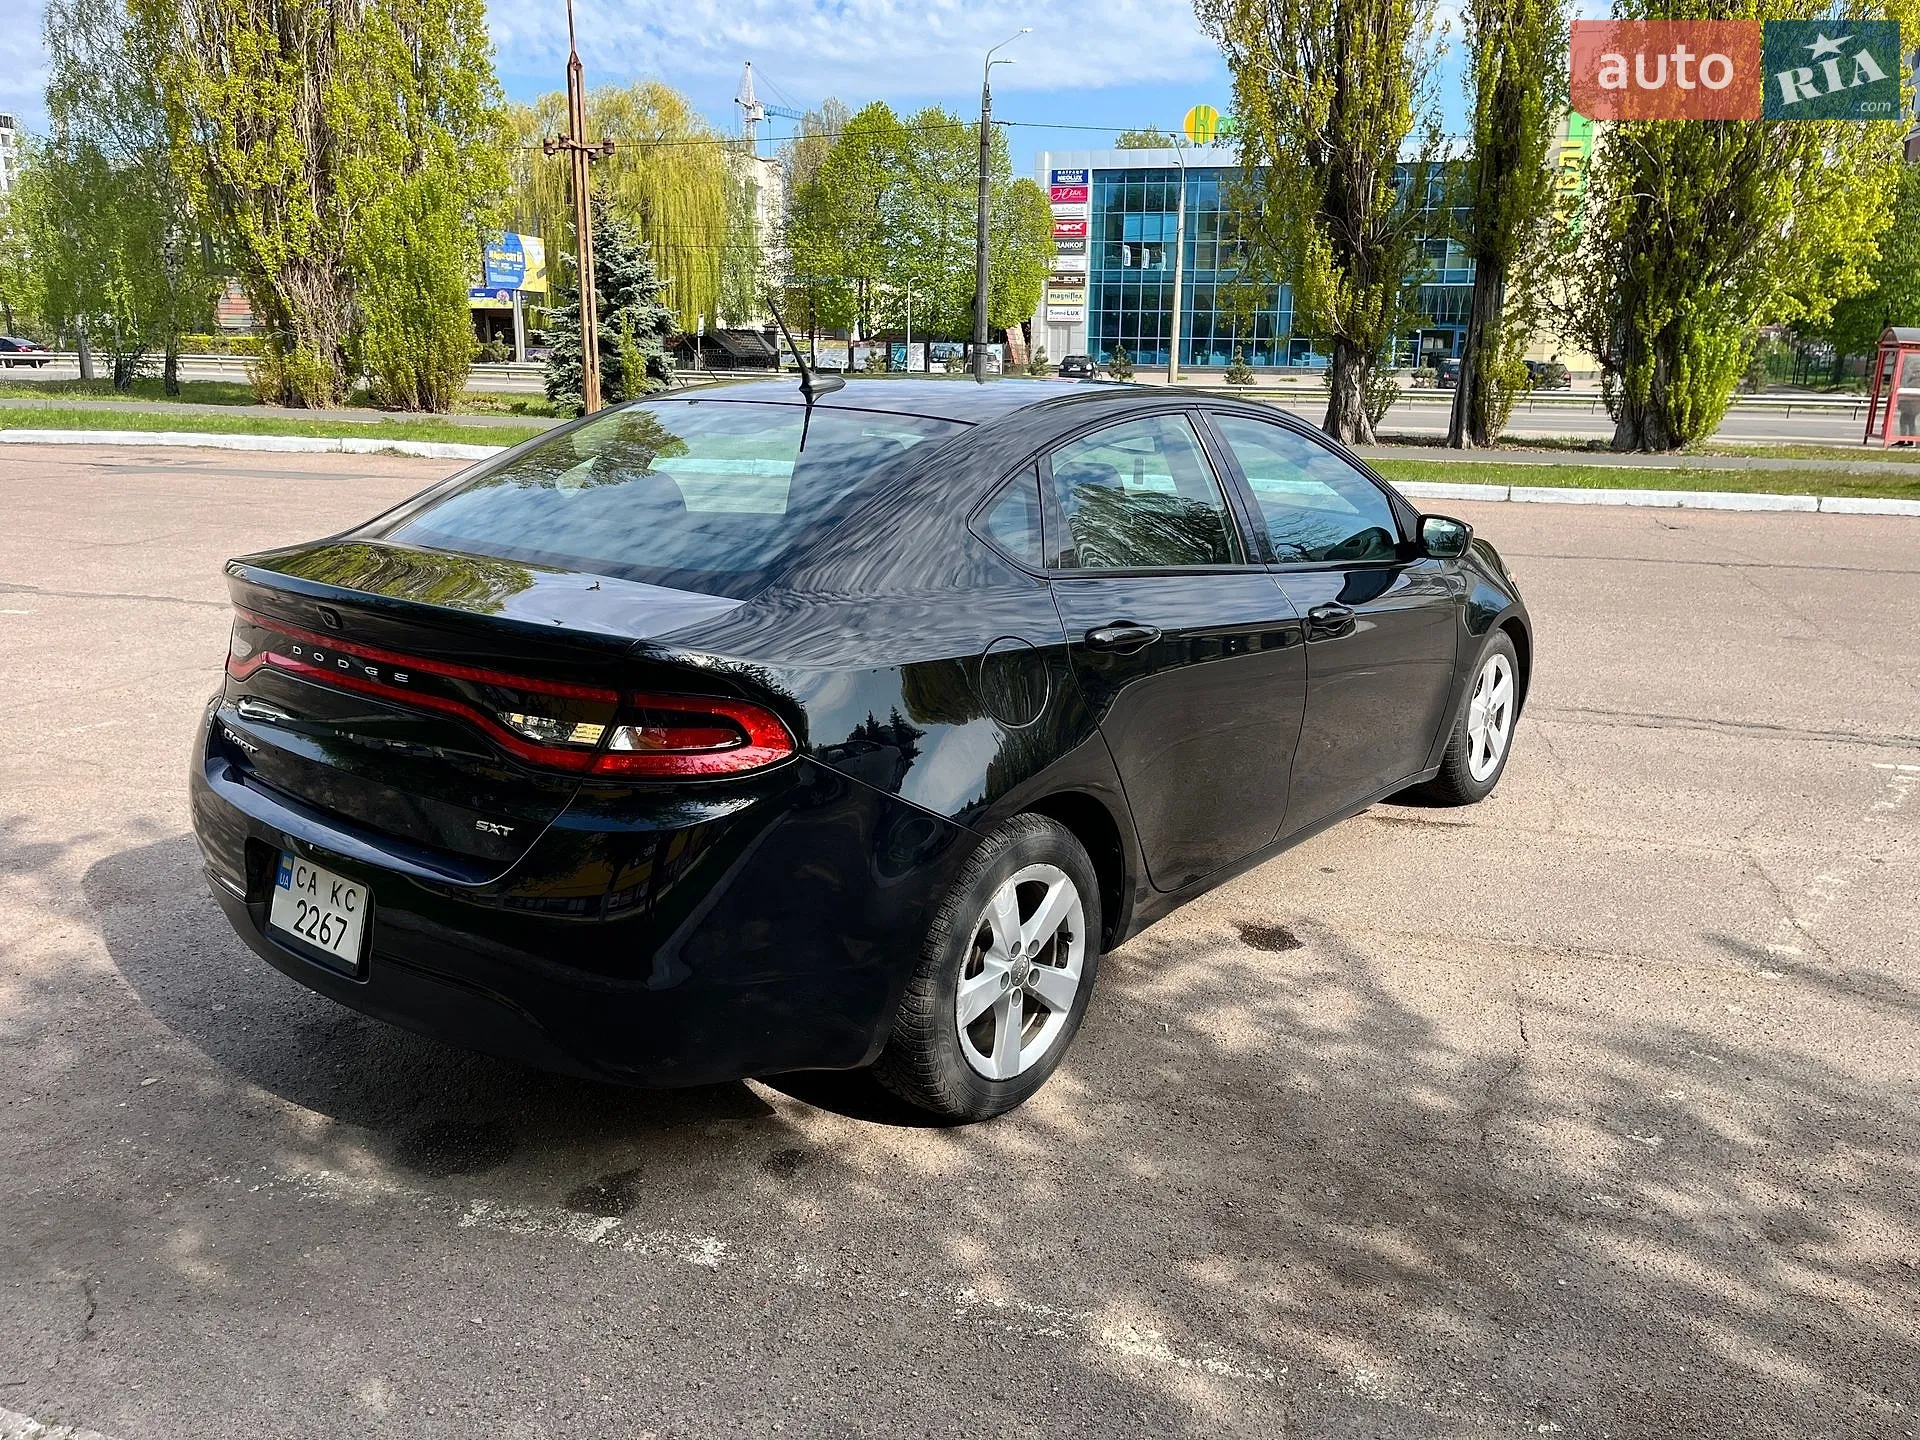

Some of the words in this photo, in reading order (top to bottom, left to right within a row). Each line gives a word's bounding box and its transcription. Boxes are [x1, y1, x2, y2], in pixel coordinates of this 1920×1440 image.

[1056, 241, 1084, 249] RANKOF
[1050, 292, 1083, 300] magniflex
[292, 645, 409, 683] DODGE
[476, 820, 515, 837] SXT
[280, 872, 290, 887] UA
[296, 866, 318, 896] CA
[330, 880, 357, 912] KC
[293, 899, 349, 951] 2267
